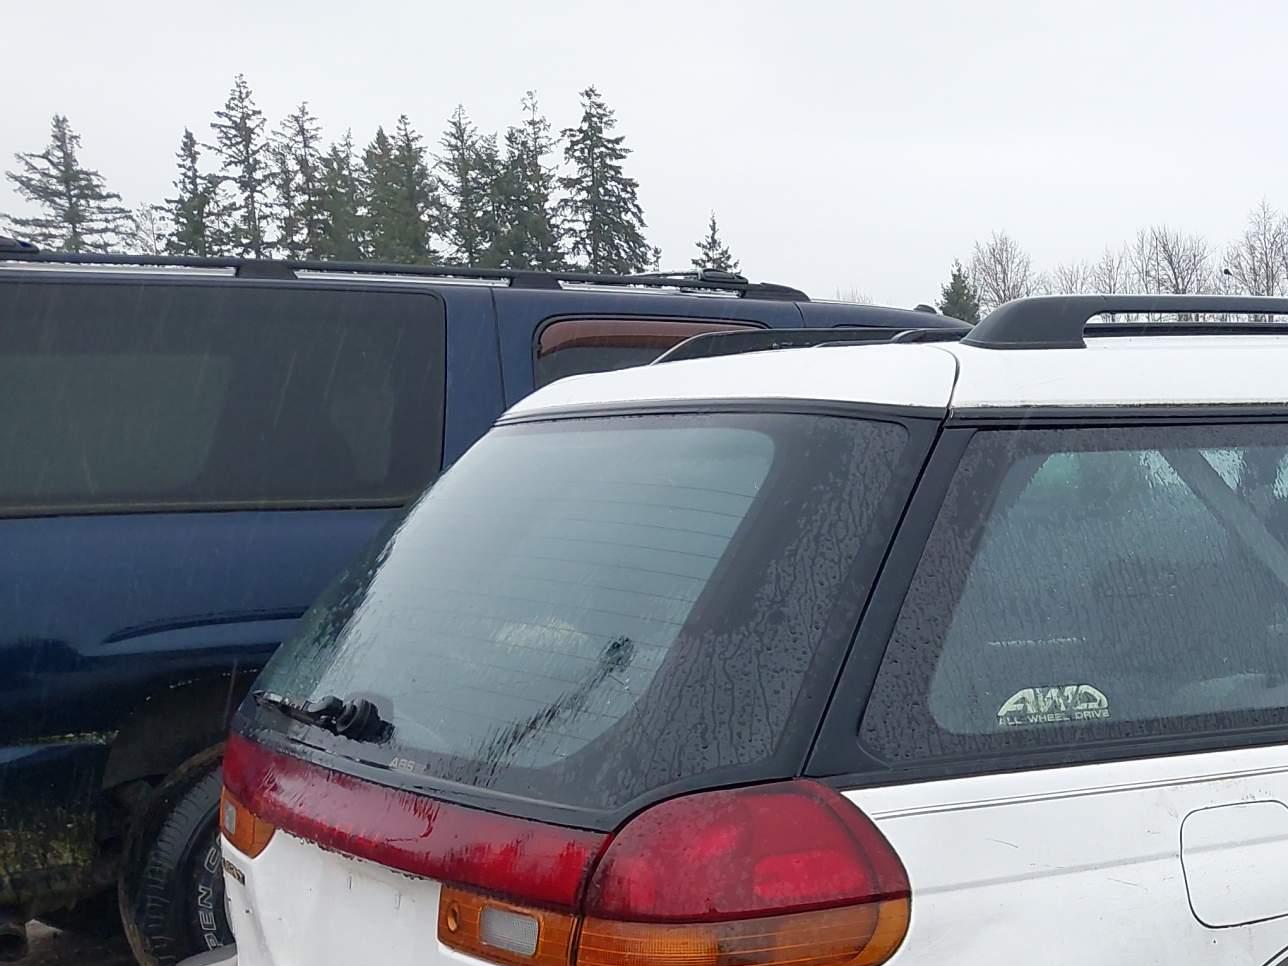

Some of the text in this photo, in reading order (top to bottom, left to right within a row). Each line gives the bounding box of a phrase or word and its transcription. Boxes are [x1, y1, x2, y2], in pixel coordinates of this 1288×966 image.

[997, 684, 1109, 717] AWD
[998, 709, 1110, 726] ALL WHEEL DRIVE
